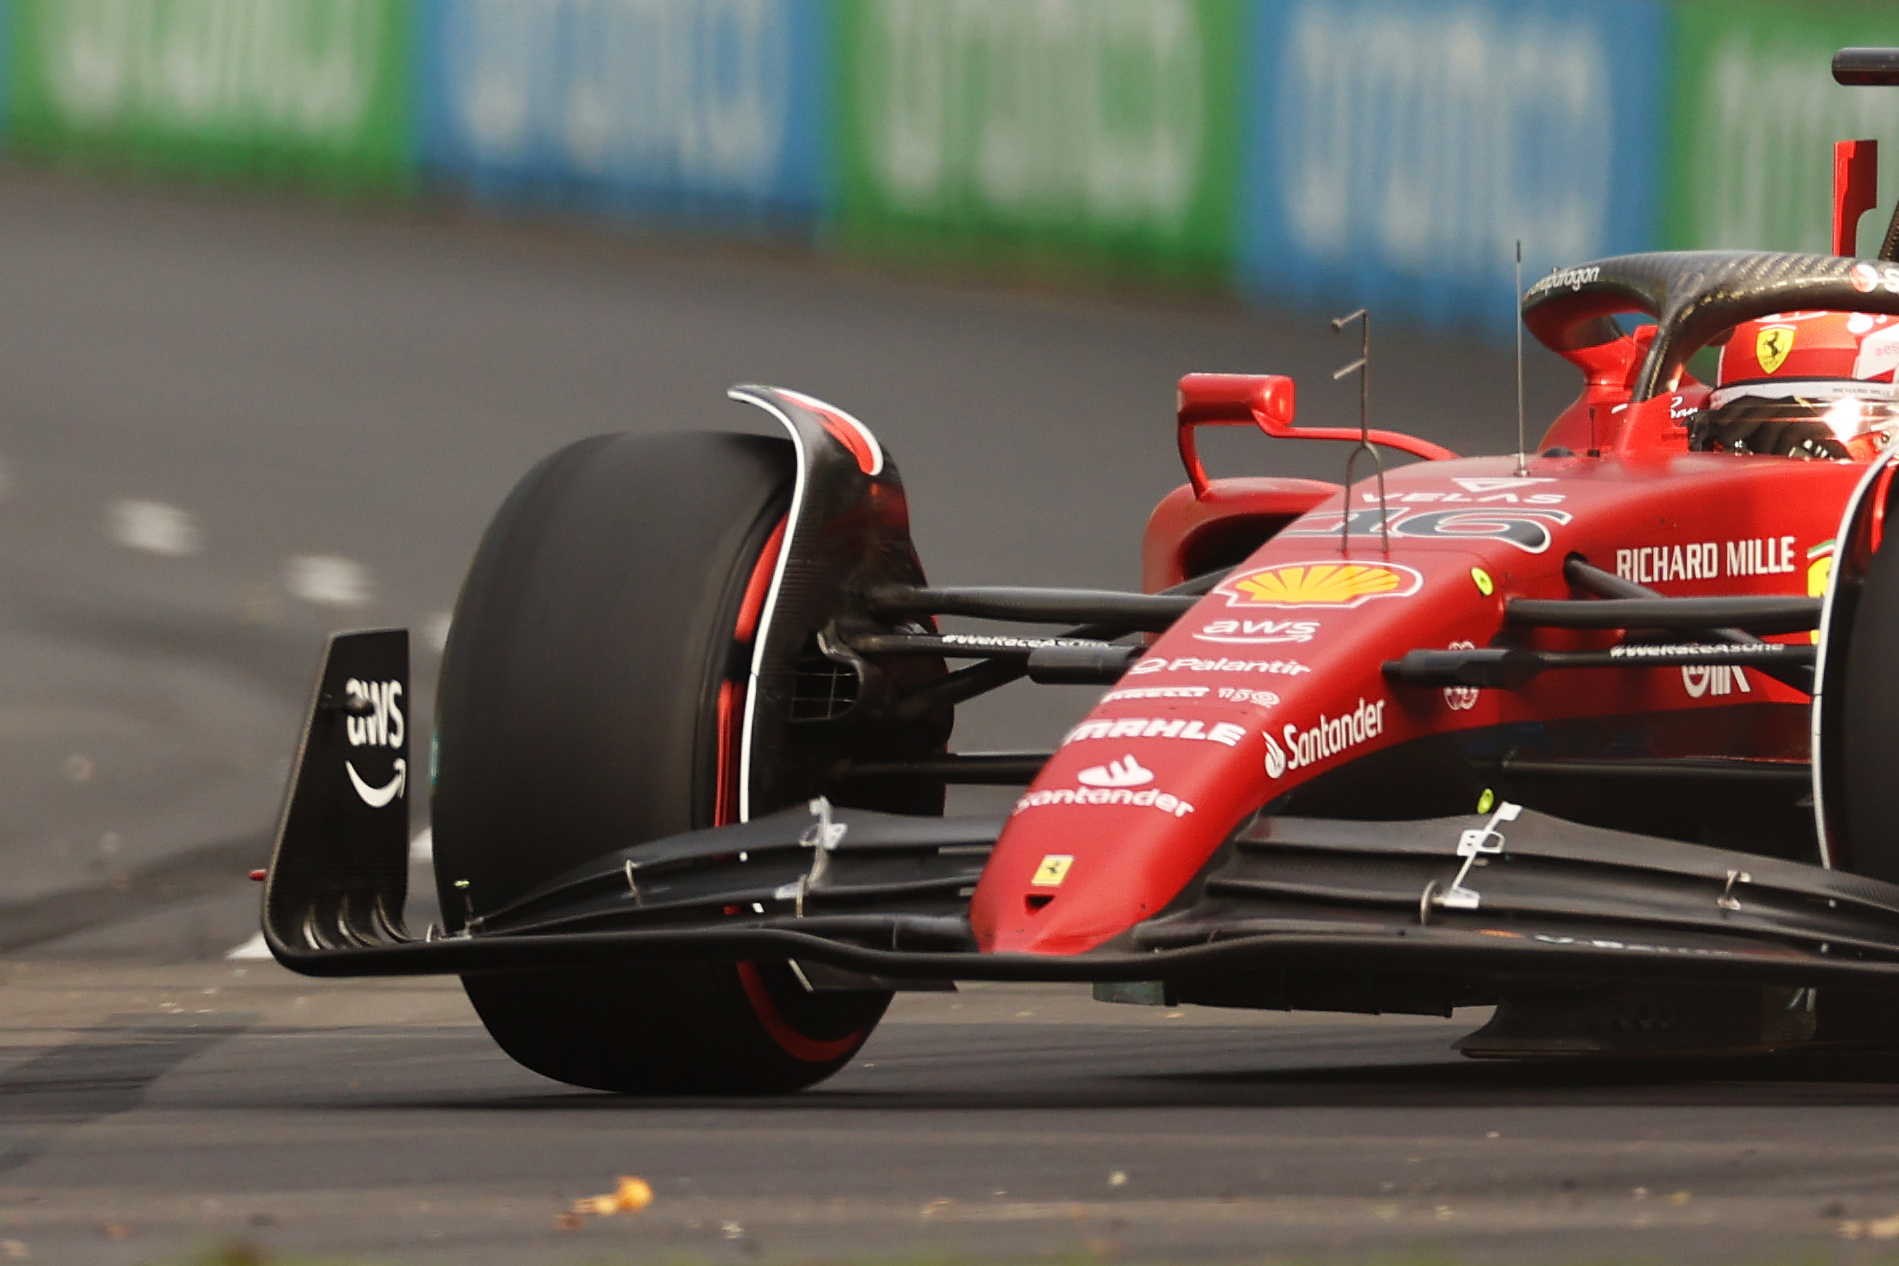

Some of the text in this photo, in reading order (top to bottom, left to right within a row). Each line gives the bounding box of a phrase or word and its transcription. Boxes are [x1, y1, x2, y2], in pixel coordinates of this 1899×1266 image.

[1362, 492, 1567, 504] VELAS
[1280, 506, 1574, 554] 16
[1617, 536, 1795, 583] RICHARD MILLE
[1203, 620, 1320, 635] aws
[1167, 658, 1311, 676] Palantir
[346, 677, 405, 750] aws
[1061, 717, 1247, 747] MAHLE
[1286, 697, 1385, 771] Santander
